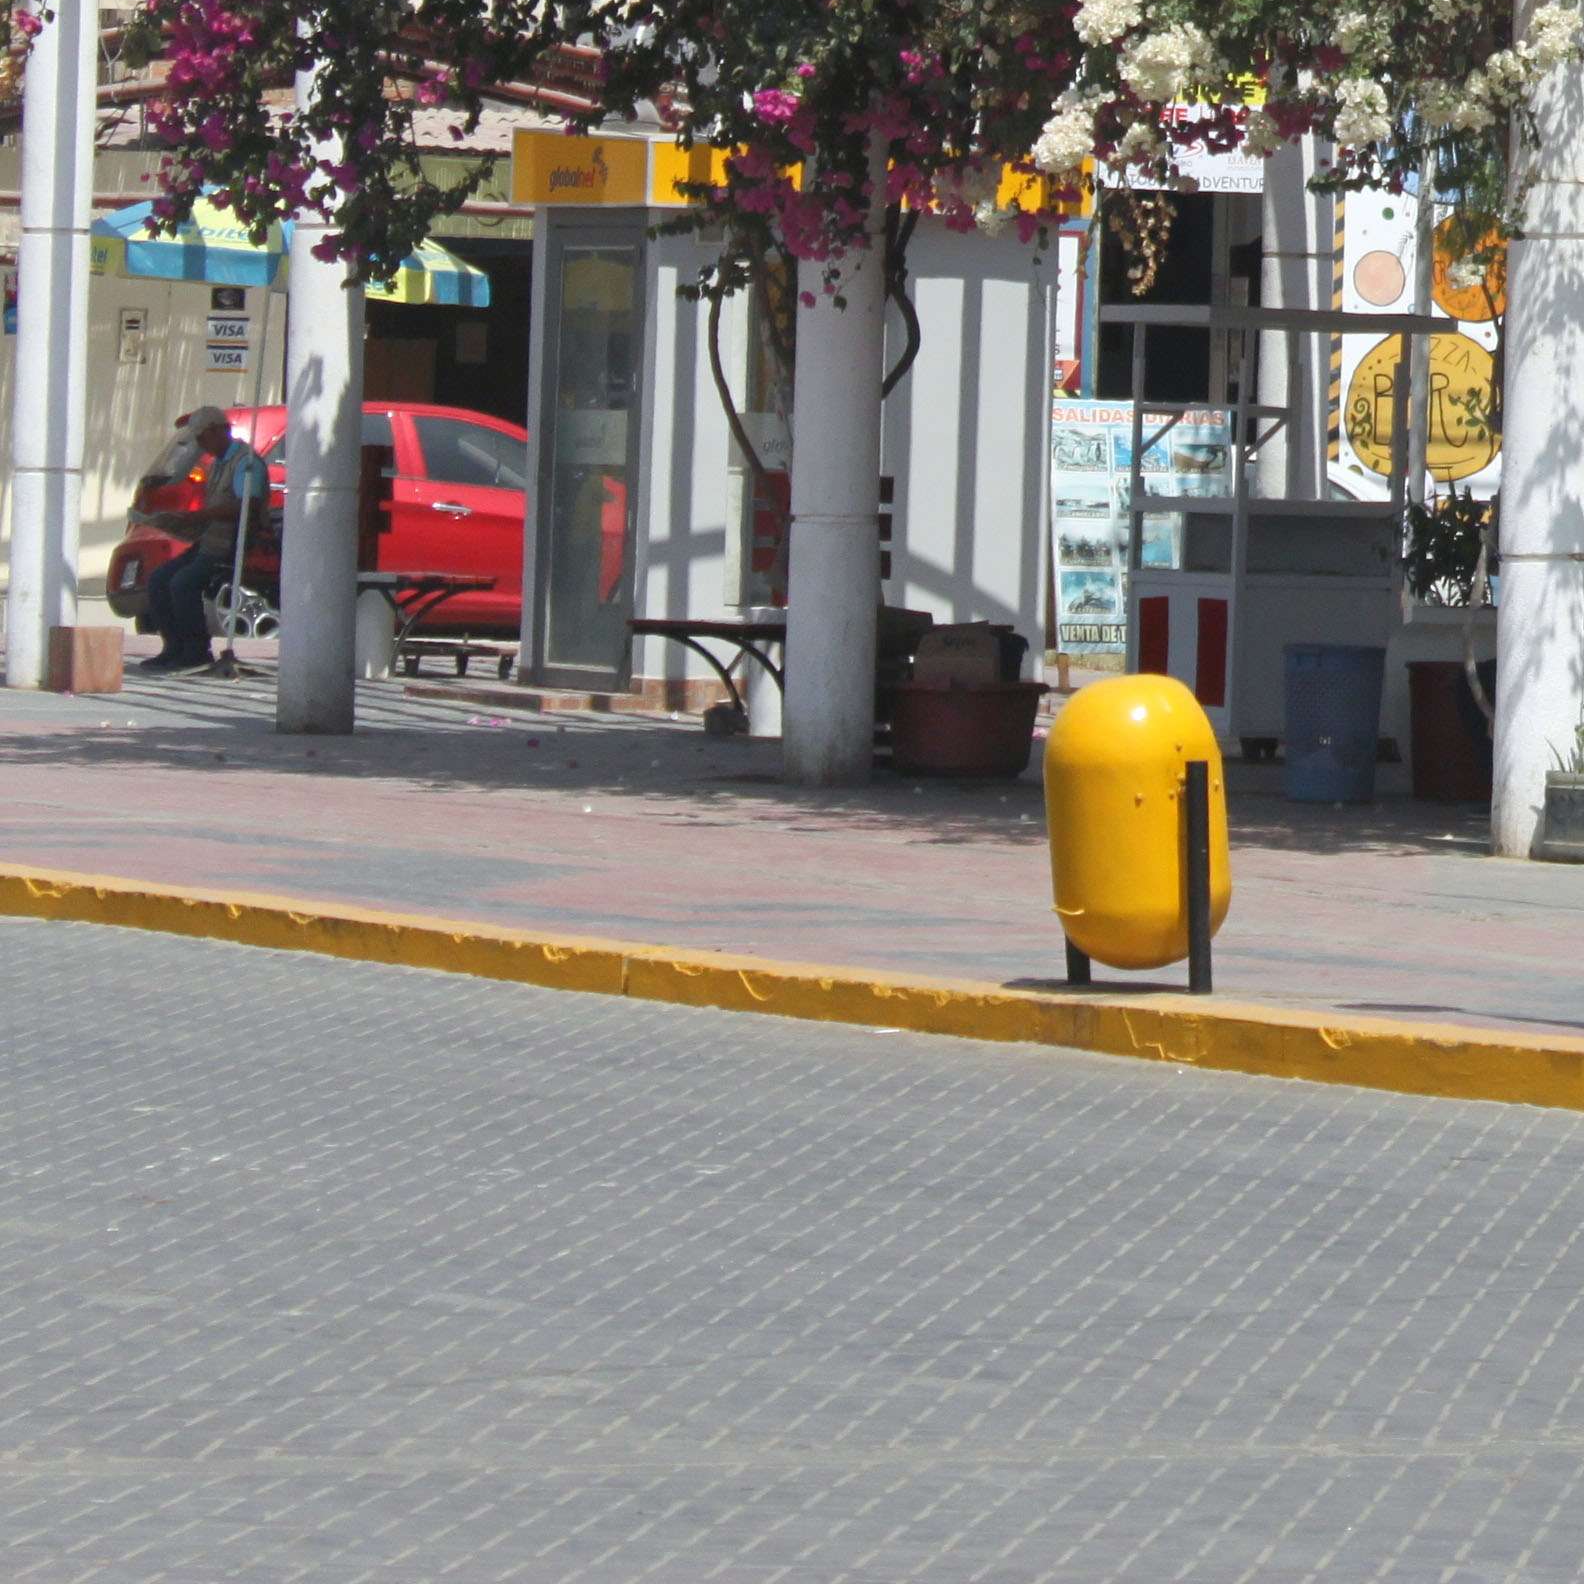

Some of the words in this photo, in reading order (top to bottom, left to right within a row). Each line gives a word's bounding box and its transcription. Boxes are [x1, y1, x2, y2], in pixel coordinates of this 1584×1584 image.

[213, 324, 245, 337] VISA
[213, 352, 243, 365] VISA
[1052, 407, 1134, 423] SALIDAS
[1373, 372, 1469, 448] BR
[1060, 624, 1100, 643] VENTA
[1101, 624, 1118, 643] DE
